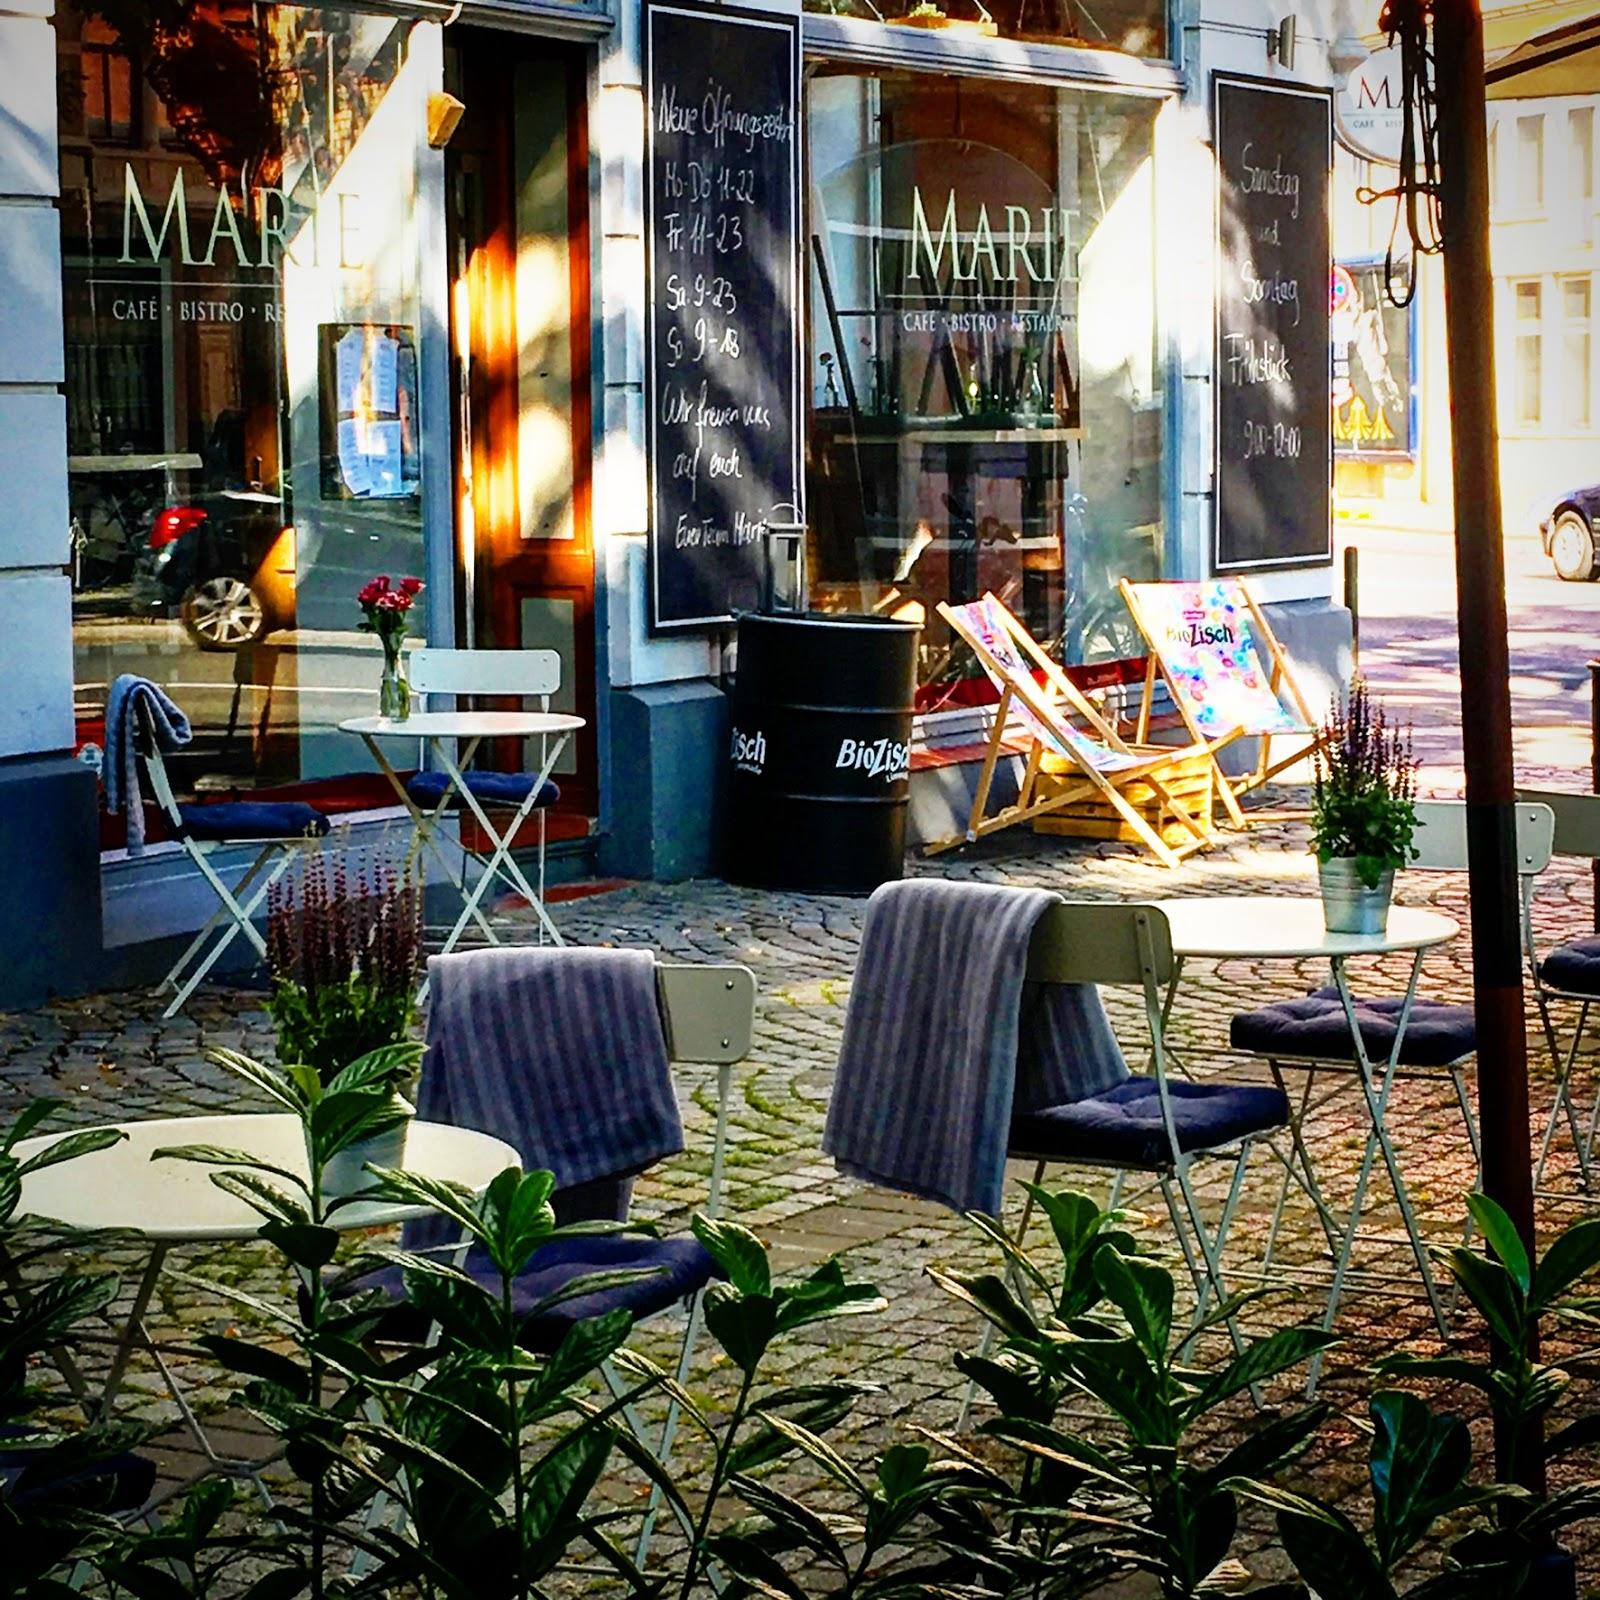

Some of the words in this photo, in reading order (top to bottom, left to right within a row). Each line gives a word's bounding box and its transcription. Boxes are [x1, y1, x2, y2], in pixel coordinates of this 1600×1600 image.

[658, 85, 698, 135] Neue
[116, 161, 364, 270] MARIE
[907, 185, 1081, 282] MARIE
[112, 296, 158, 321] CAFÉ
[180, 301, 244, 323] BISTRO
[951, 312, 997, 333] BISTRO
